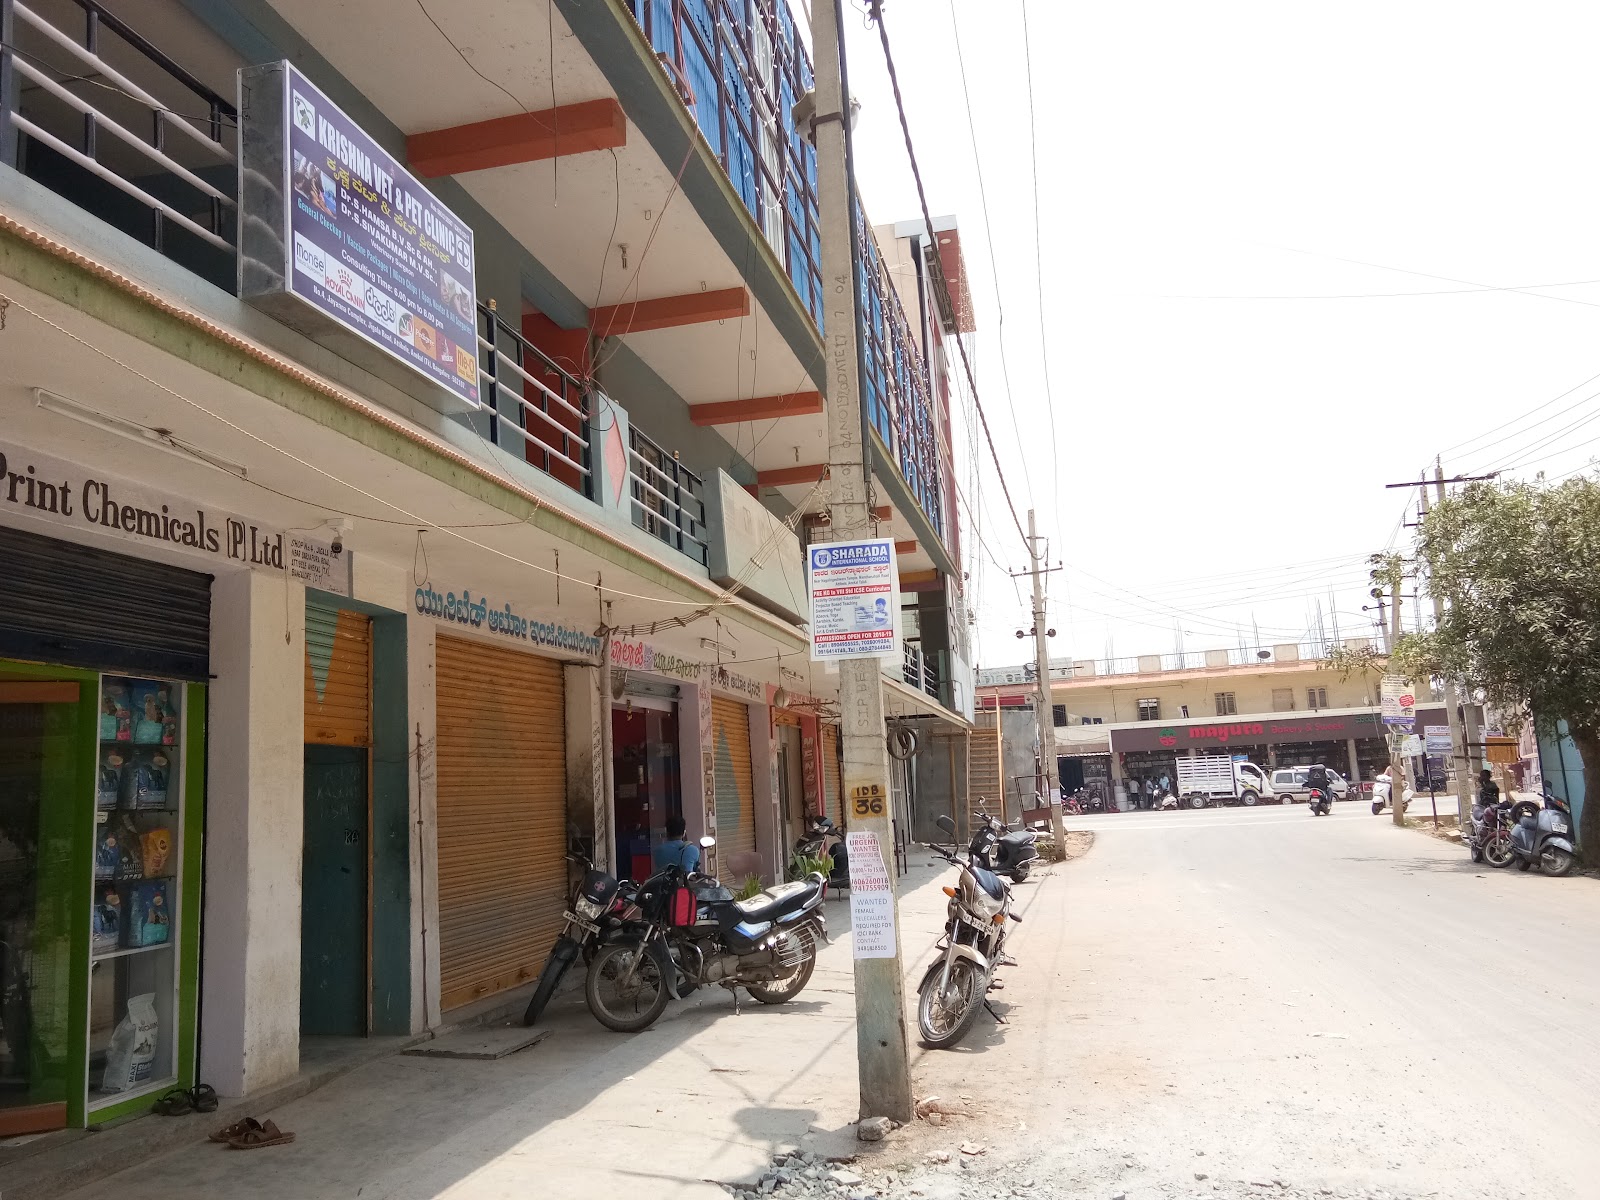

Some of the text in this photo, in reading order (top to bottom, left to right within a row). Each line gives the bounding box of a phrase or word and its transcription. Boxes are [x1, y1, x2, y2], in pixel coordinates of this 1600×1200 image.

[319, 115, 372, 186] KRISHNA
[374, 163, 393, 204] VET
[395, 186, 403, 213] &
[405, 191, 422, 229] PET
[424, 208, 454, 257] CLINIC
[327, 155, 349, 190] ಕೃಷ್ಣ
[352, 175, 377, 207] ವೆಟ್
[381, 199, 391, 218] &
[394, 210, 416, 238] ಪೆಟ್
[298, 197, 318, 221] General
[320, 214, 341, 239] Checkup
[370, 238, 393, 262] Veterinary
[342, 249, 375, 281] Consulting
[377, 274, 392, 292] Time:
[326, 276, 344, 296] ROYAL
[82, 479, 219, 553] Chemicals
[832, 546, 887, 560] SHARADA
[816, 634, 846, 642] ADMISSIONS
[1189, 723, 1263, 742] mayura
[856, 784, 879, 796] IDB
[855, 798, 883, 815] 36
